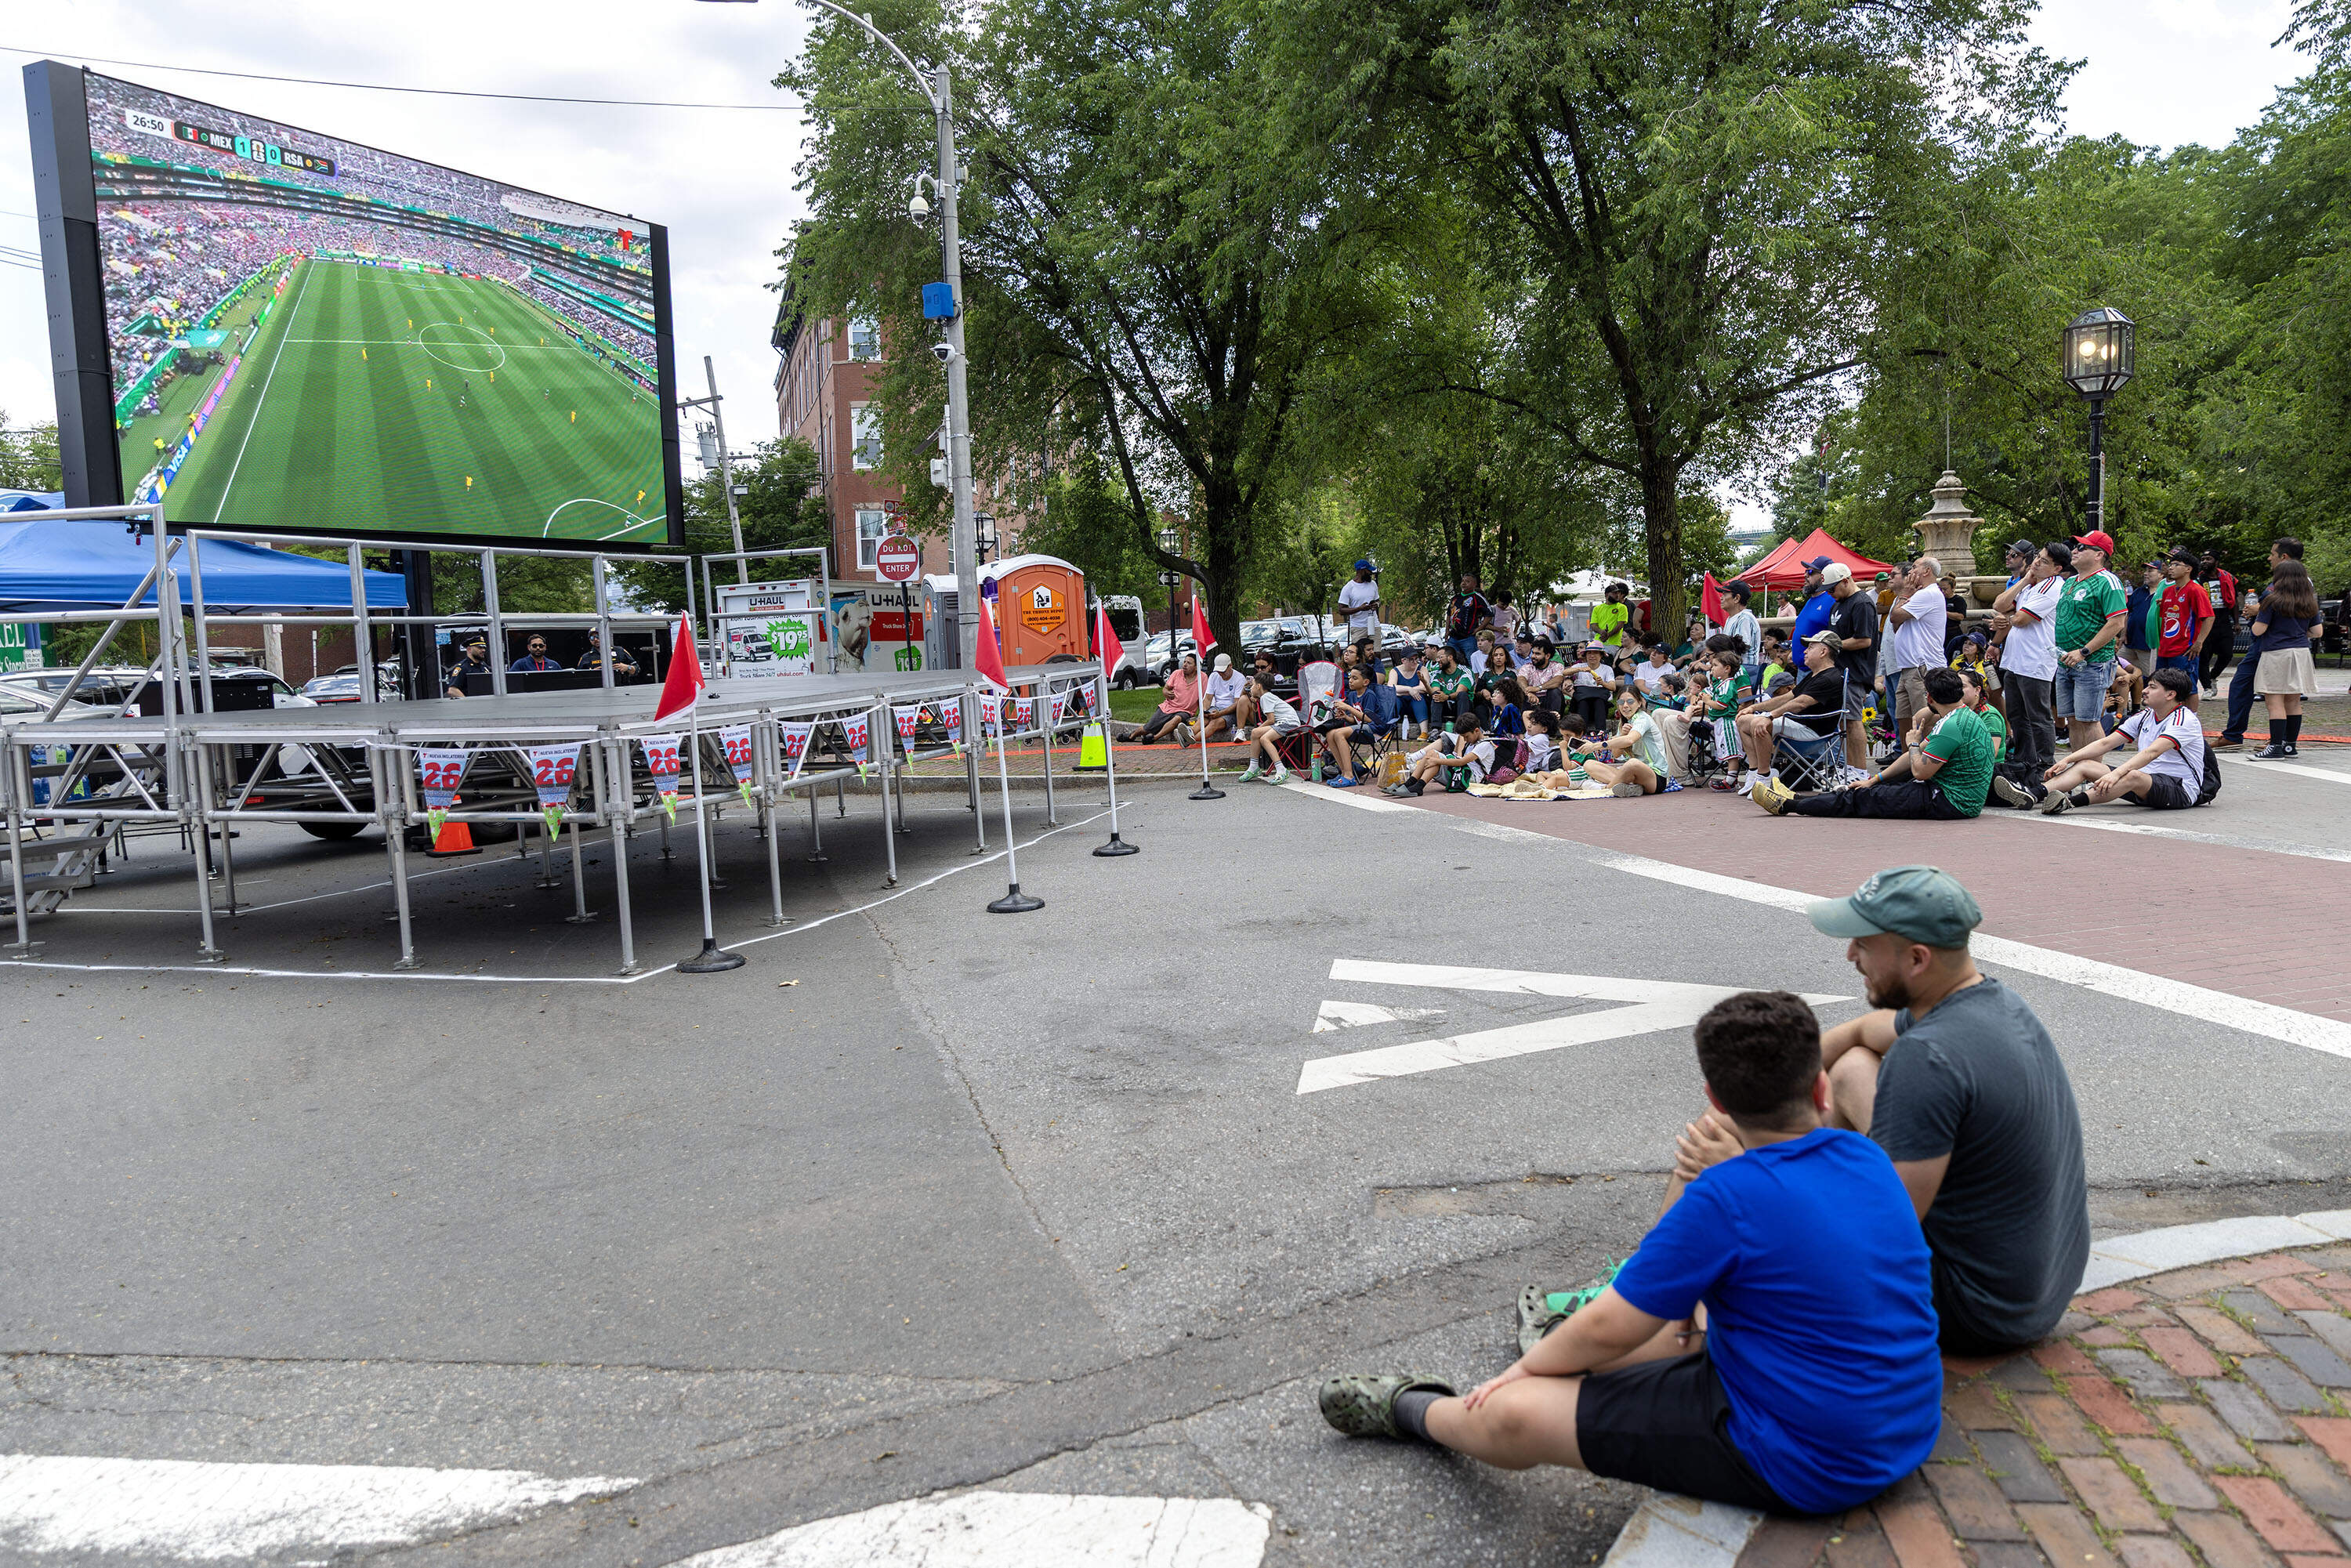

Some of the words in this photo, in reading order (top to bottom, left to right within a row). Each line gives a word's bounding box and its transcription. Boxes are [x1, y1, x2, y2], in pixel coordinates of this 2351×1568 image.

[132, 114, 164, 132] 26:50
[210, 133, 233, 151] MEX
[239, 140, 246, 153] 1
[270, 149, 277, 161] 0
[283, 151, 304, 168] RSA
[168, 444, 189, 473] VISA
[897, 544, 912, 552] NOT
[886, 564, 910, 573] ENTER
[1085, 689, 1096, 708] 26
[944, 707, 960, 730] 26
[982, 704, 995, 724] 26
[1017, 707, 1031, 726] 26
[847, 724, 868, 750] 26
[897, 715, 915, 737] 26
[726, 737, 752, 766] 26
[786, 734, 806, 758] 26
[535, 757, 574, 786] 26
[648, 747, 680, 775] 26
[423, 762, 462, 790] 26
